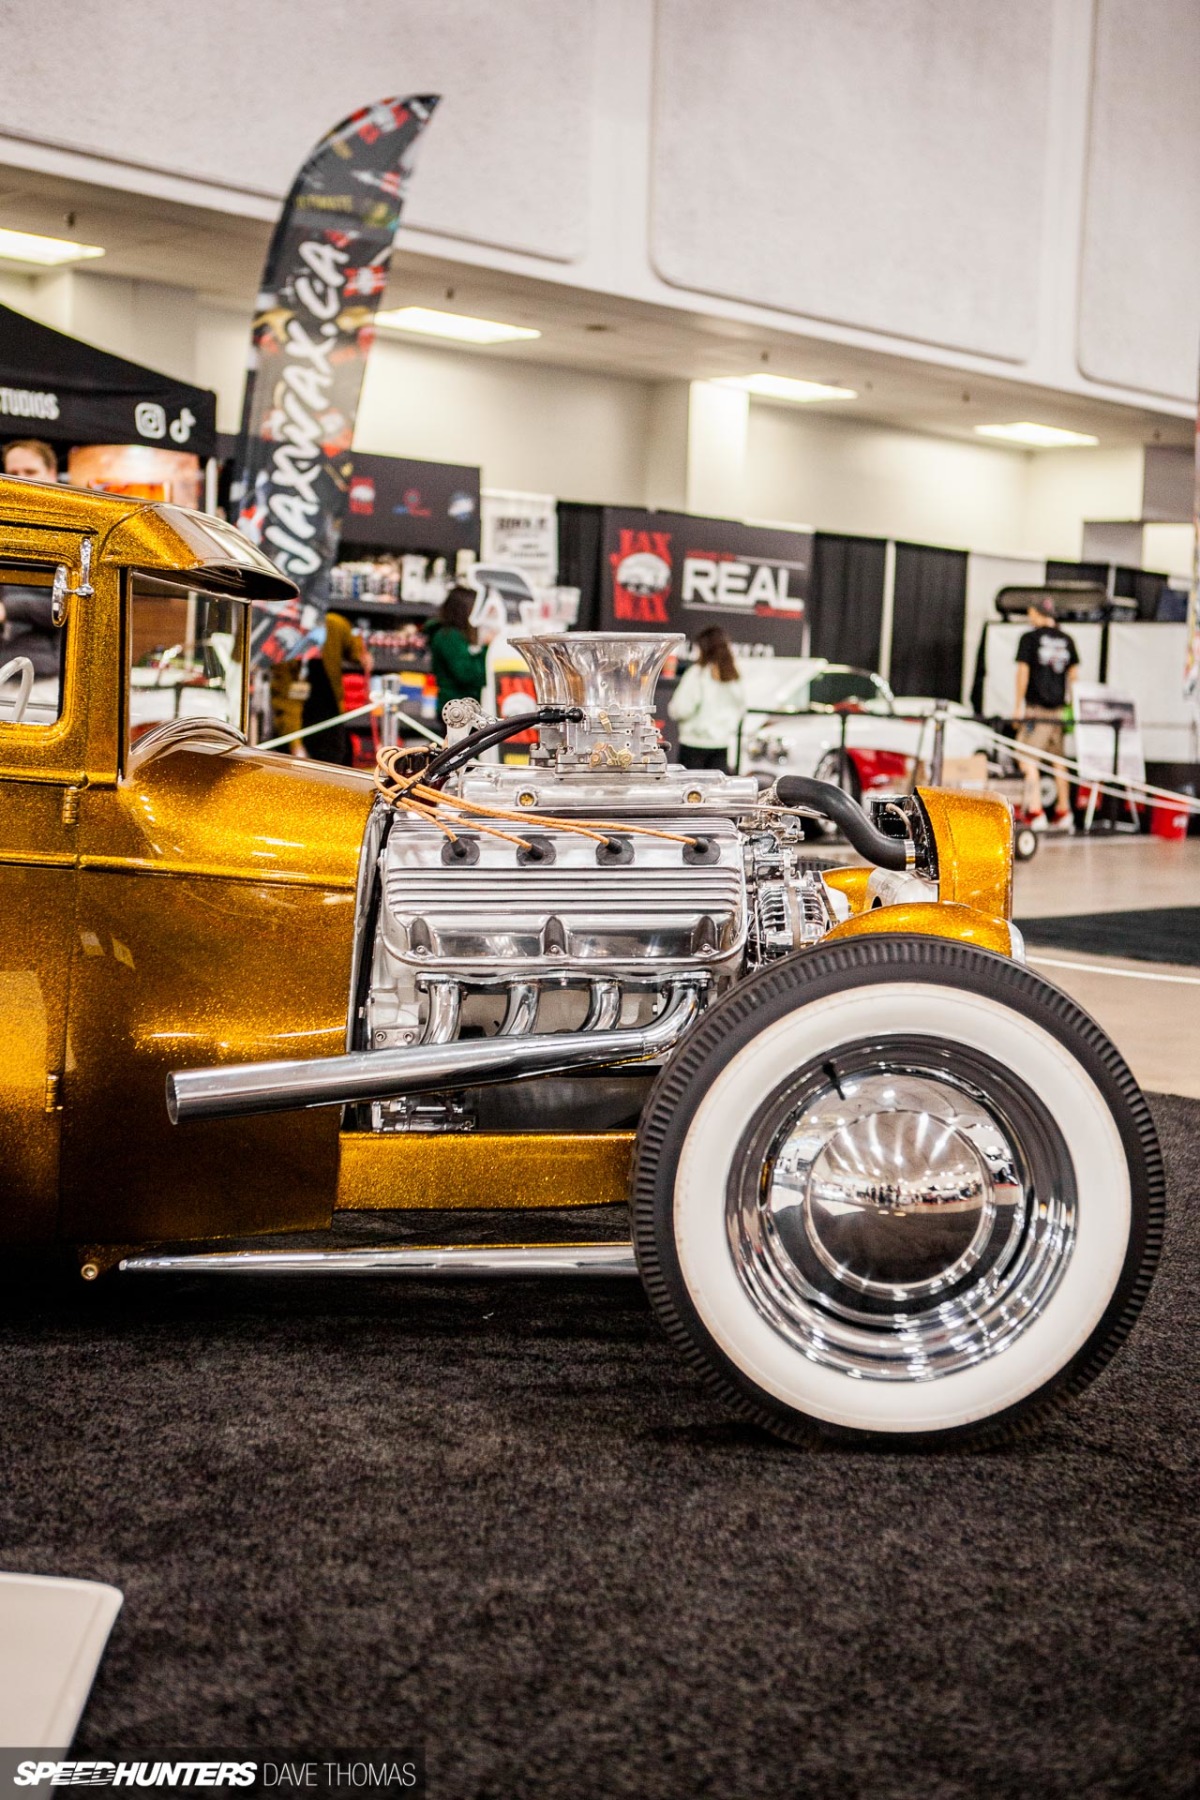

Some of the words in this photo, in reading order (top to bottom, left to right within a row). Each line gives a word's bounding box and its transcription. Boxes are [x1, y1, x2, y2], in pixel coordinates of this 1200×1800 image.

[0, 386, 60, 420] TUDIOS
[264, 241, 350, 576] JAXWAX.CA
[681, 556, 805, 611] REAL
